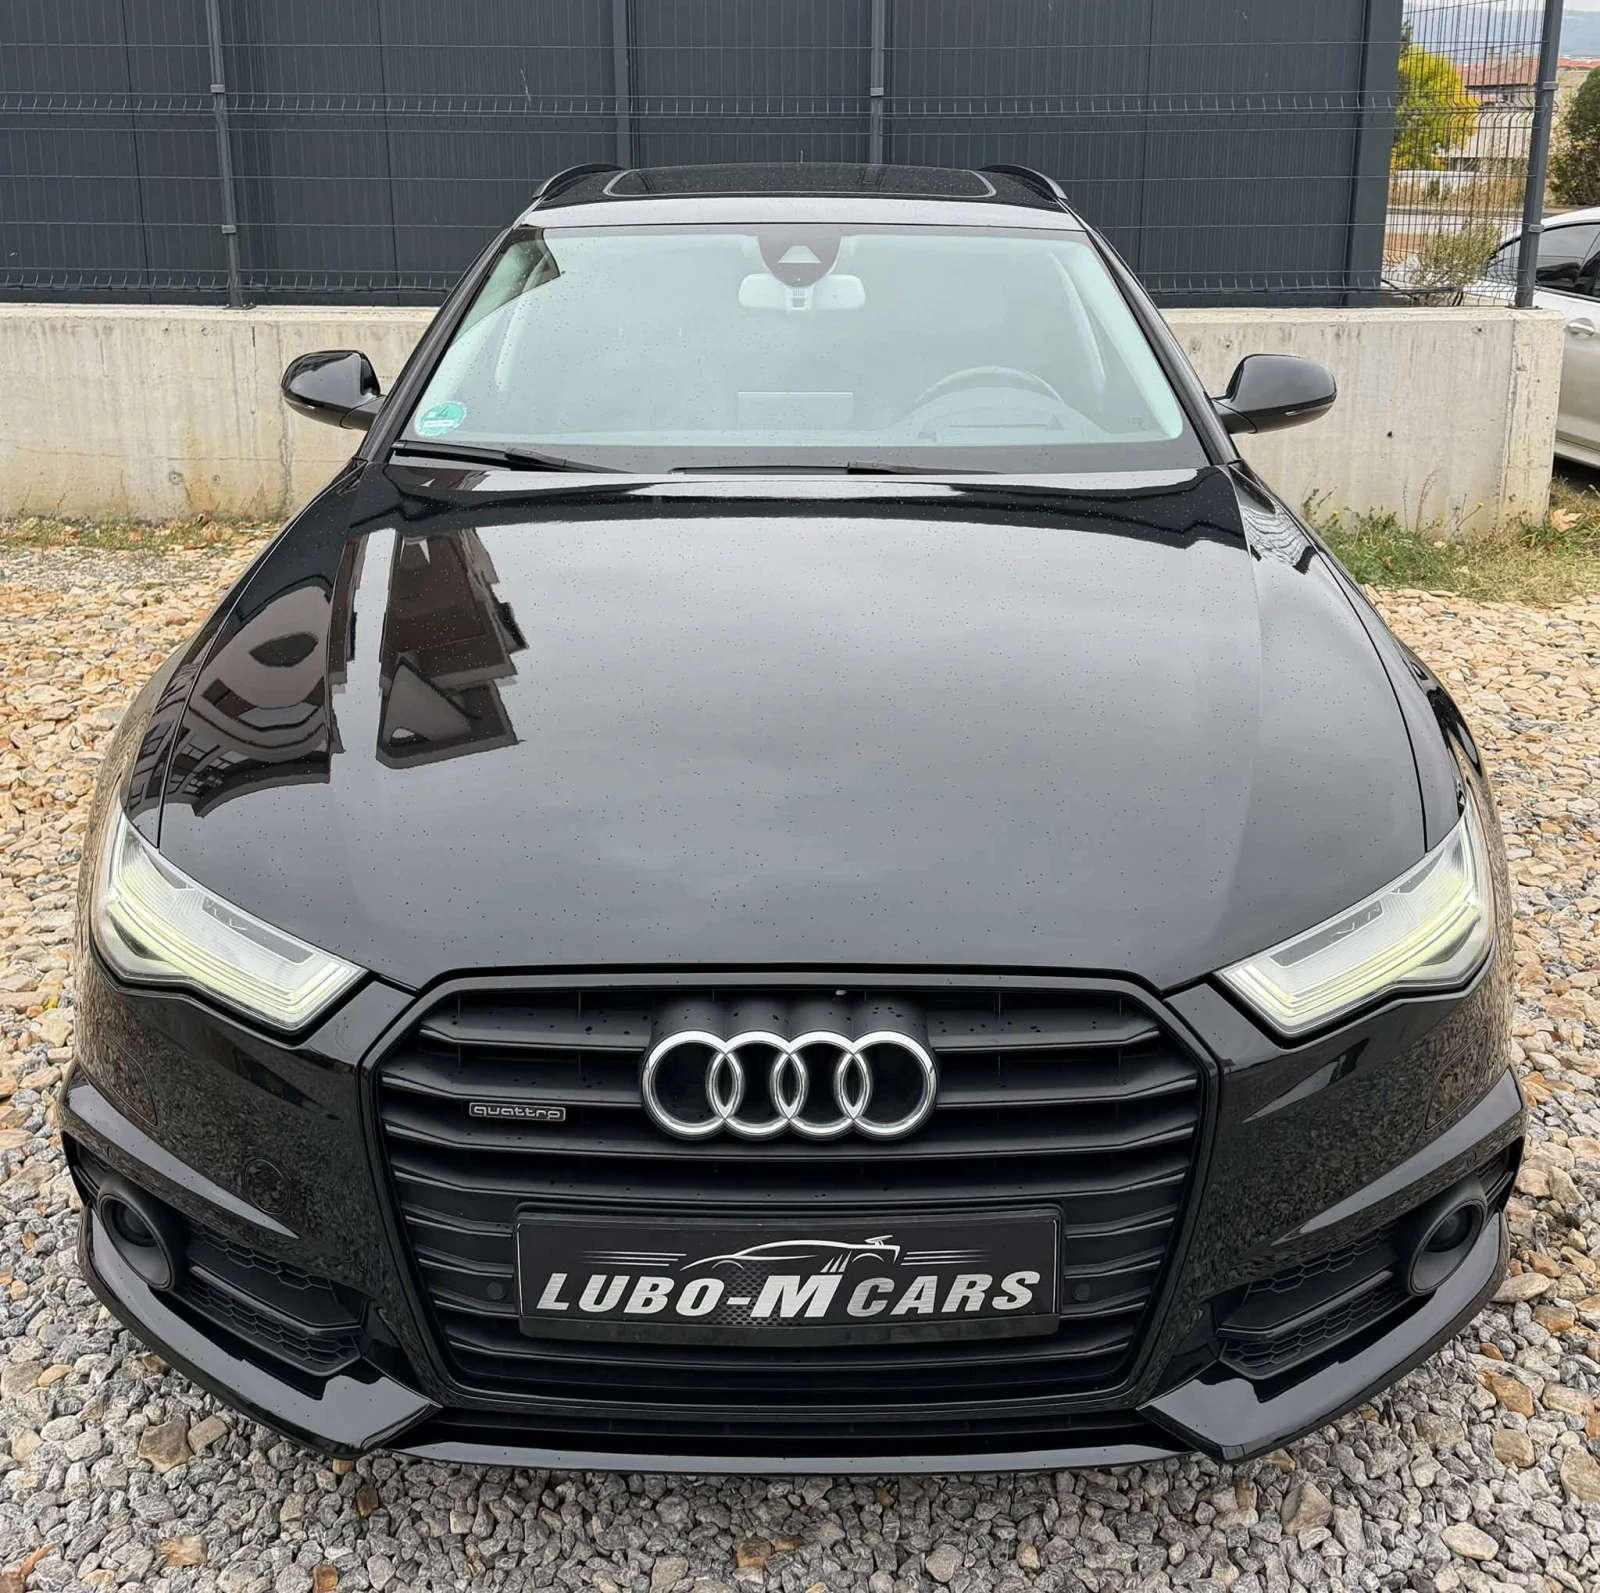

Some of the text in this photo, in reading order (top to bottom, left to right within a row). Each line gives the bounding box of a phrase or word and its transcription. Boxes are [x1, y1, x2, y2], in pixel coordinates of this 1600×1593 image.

[473, 1106, 561, 1119] quattro
[536, 1270, 1041, 1318] LUBO-M CARS
